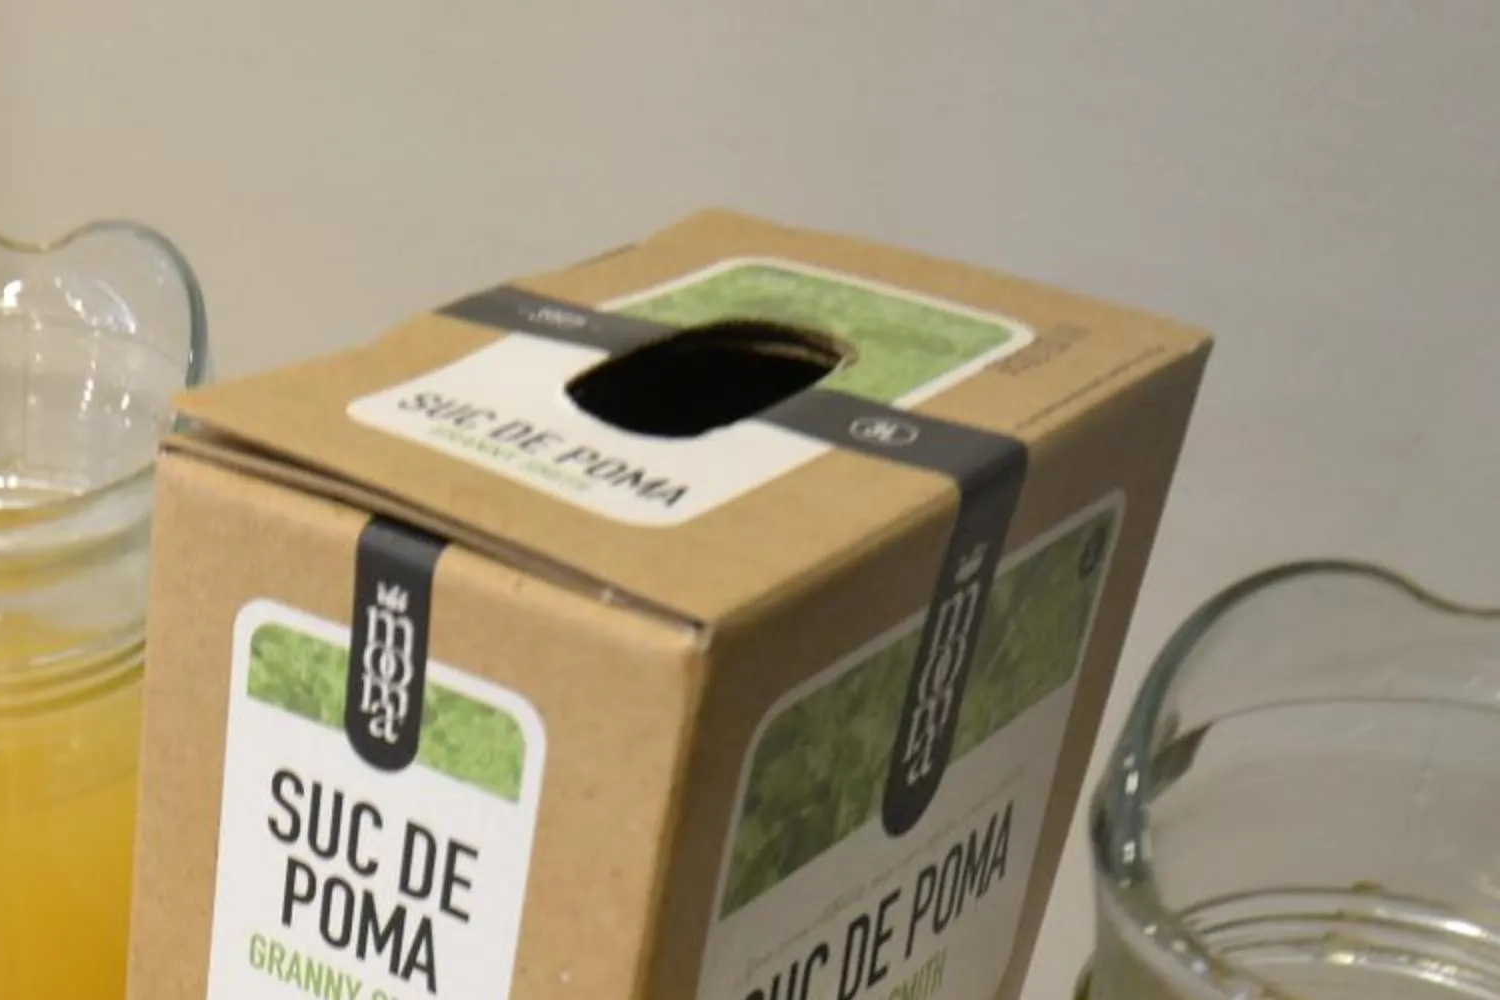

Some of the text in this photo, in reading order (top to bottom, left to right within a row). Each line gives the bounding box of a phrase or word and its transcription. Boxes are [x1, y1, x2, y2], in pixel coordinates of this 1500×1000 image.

[398, 391, 497, 429] SUC
[488, 419, 564, 453] DE
[555, 445, 689, 507] POMA
[268, 769, 479, 923] SUC DE
[904, 800, 1013, 960] POMA
[281, 856, 437, 995] POMA
